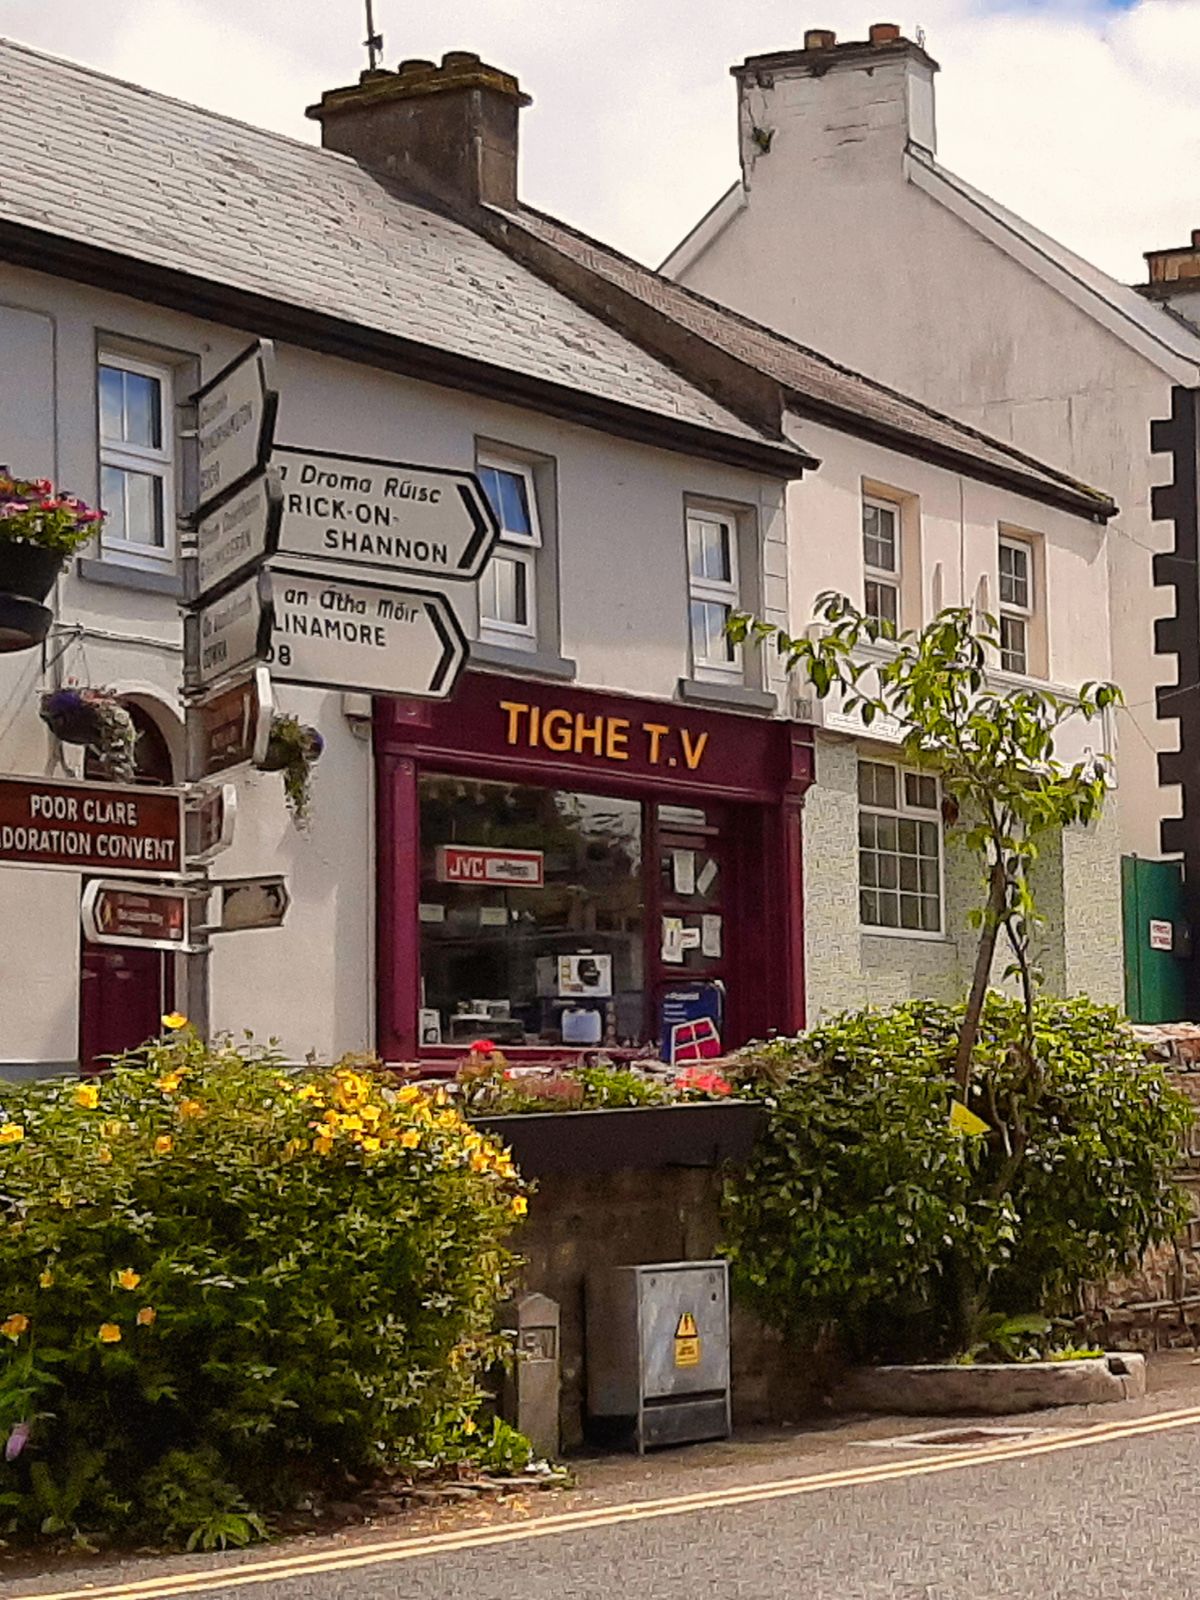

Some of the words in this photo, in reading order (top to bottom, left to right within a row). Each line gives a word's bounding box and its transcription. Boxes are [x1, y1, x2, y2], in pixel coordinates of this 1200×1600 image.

[300, 464, 372, 494] Droma
[282, 493, 400, 527] RICK-ON-
[324, 528, 448, 565] SHANNON
[284, 588, 308, 606] an
[272, 612, 387, 647] LINAMORE
[500, 700, 631, 761] TIGHE
[642, 722, 709, 770] T.V
[30, 794, 79, 822] POOR
[83, 798, 138, 827] CLARE
[0, 825, 92, 856] DORATION
[96, 833, 176, 862] CONVENT
[449, 856, 485, 878] JVC
